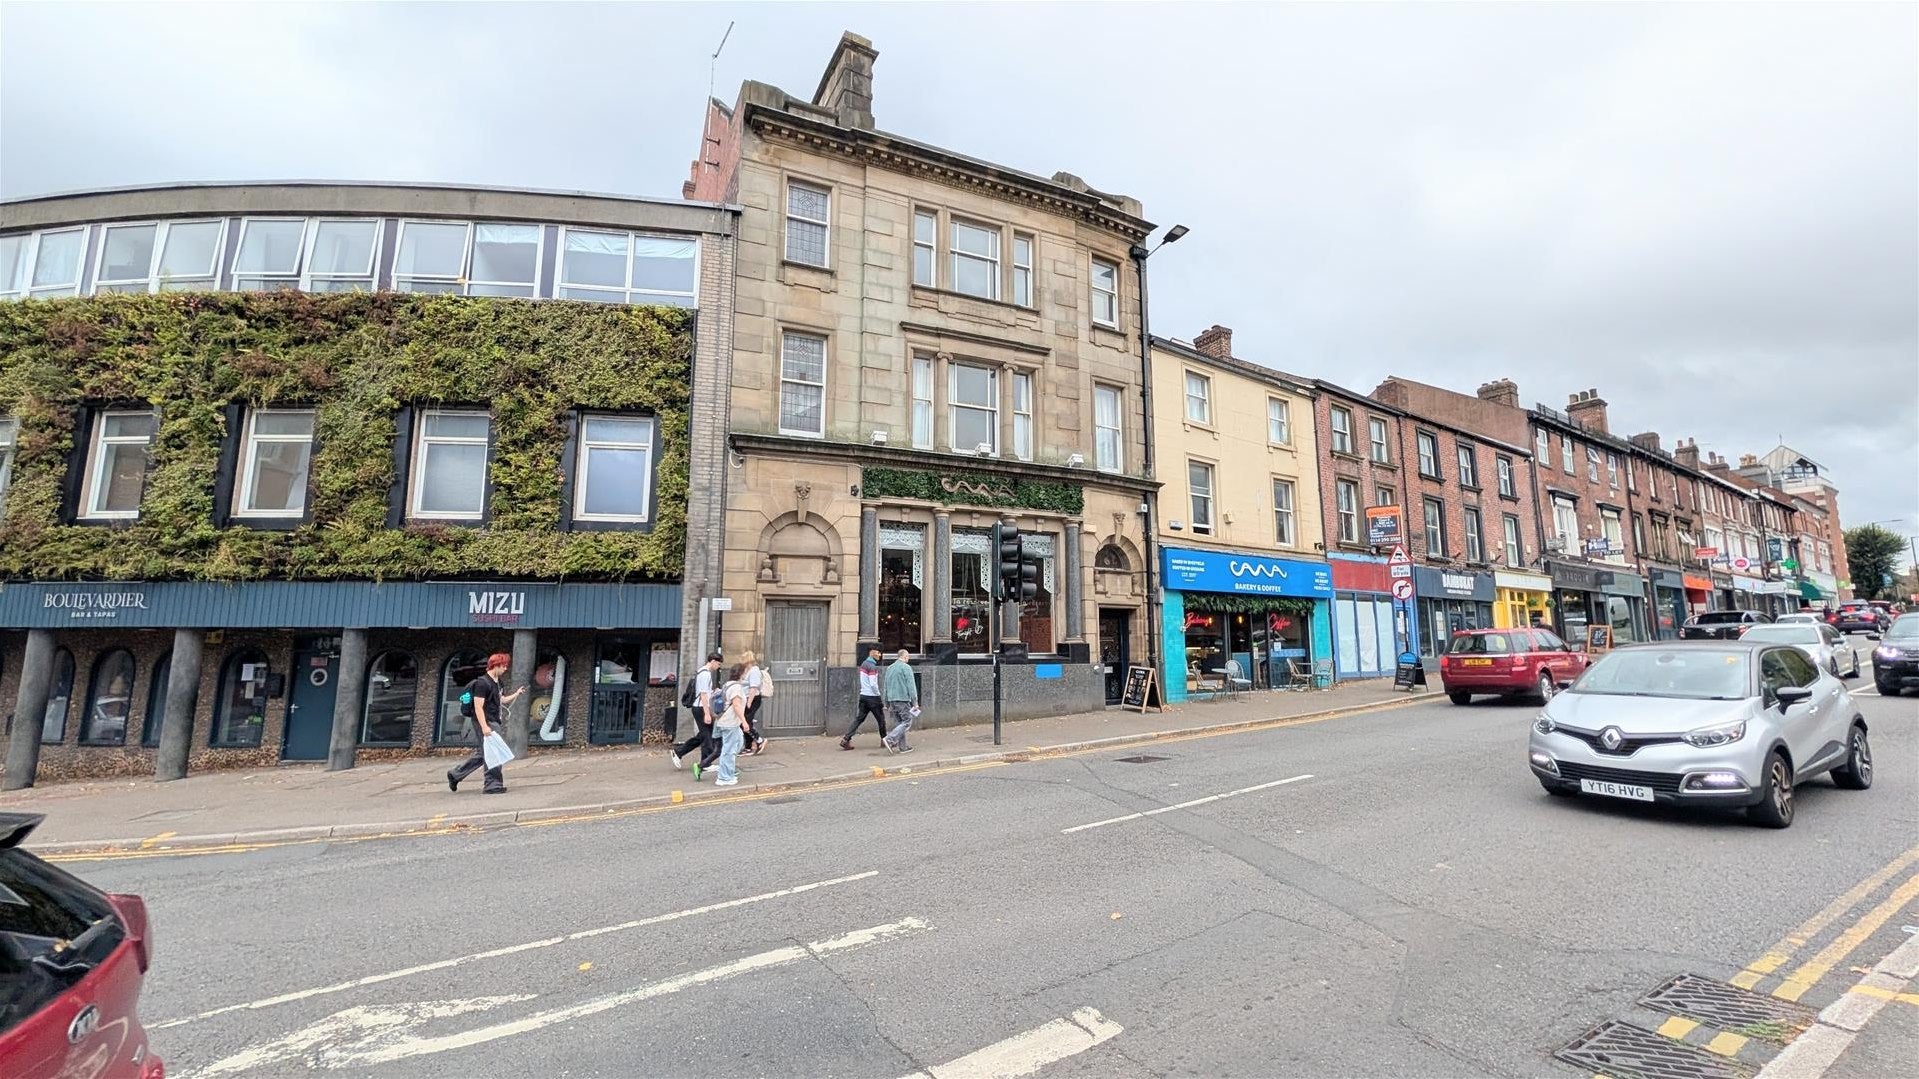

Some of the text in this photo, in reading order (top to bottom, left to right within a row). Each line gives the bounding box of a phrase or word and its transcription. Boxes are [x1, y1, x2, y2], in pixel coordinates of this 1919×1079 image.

[1235, 583, 1257, 592] BAKERY
[1262, 585, 1282, 593] COFFEE
[44, 592, 148, 610] BOULEVARDIER
[469, 592, 525, 614] MIZU
[473, 615, 499, 623] SUSHI
[1588, 781, 1645, 798] YT16 HVG
